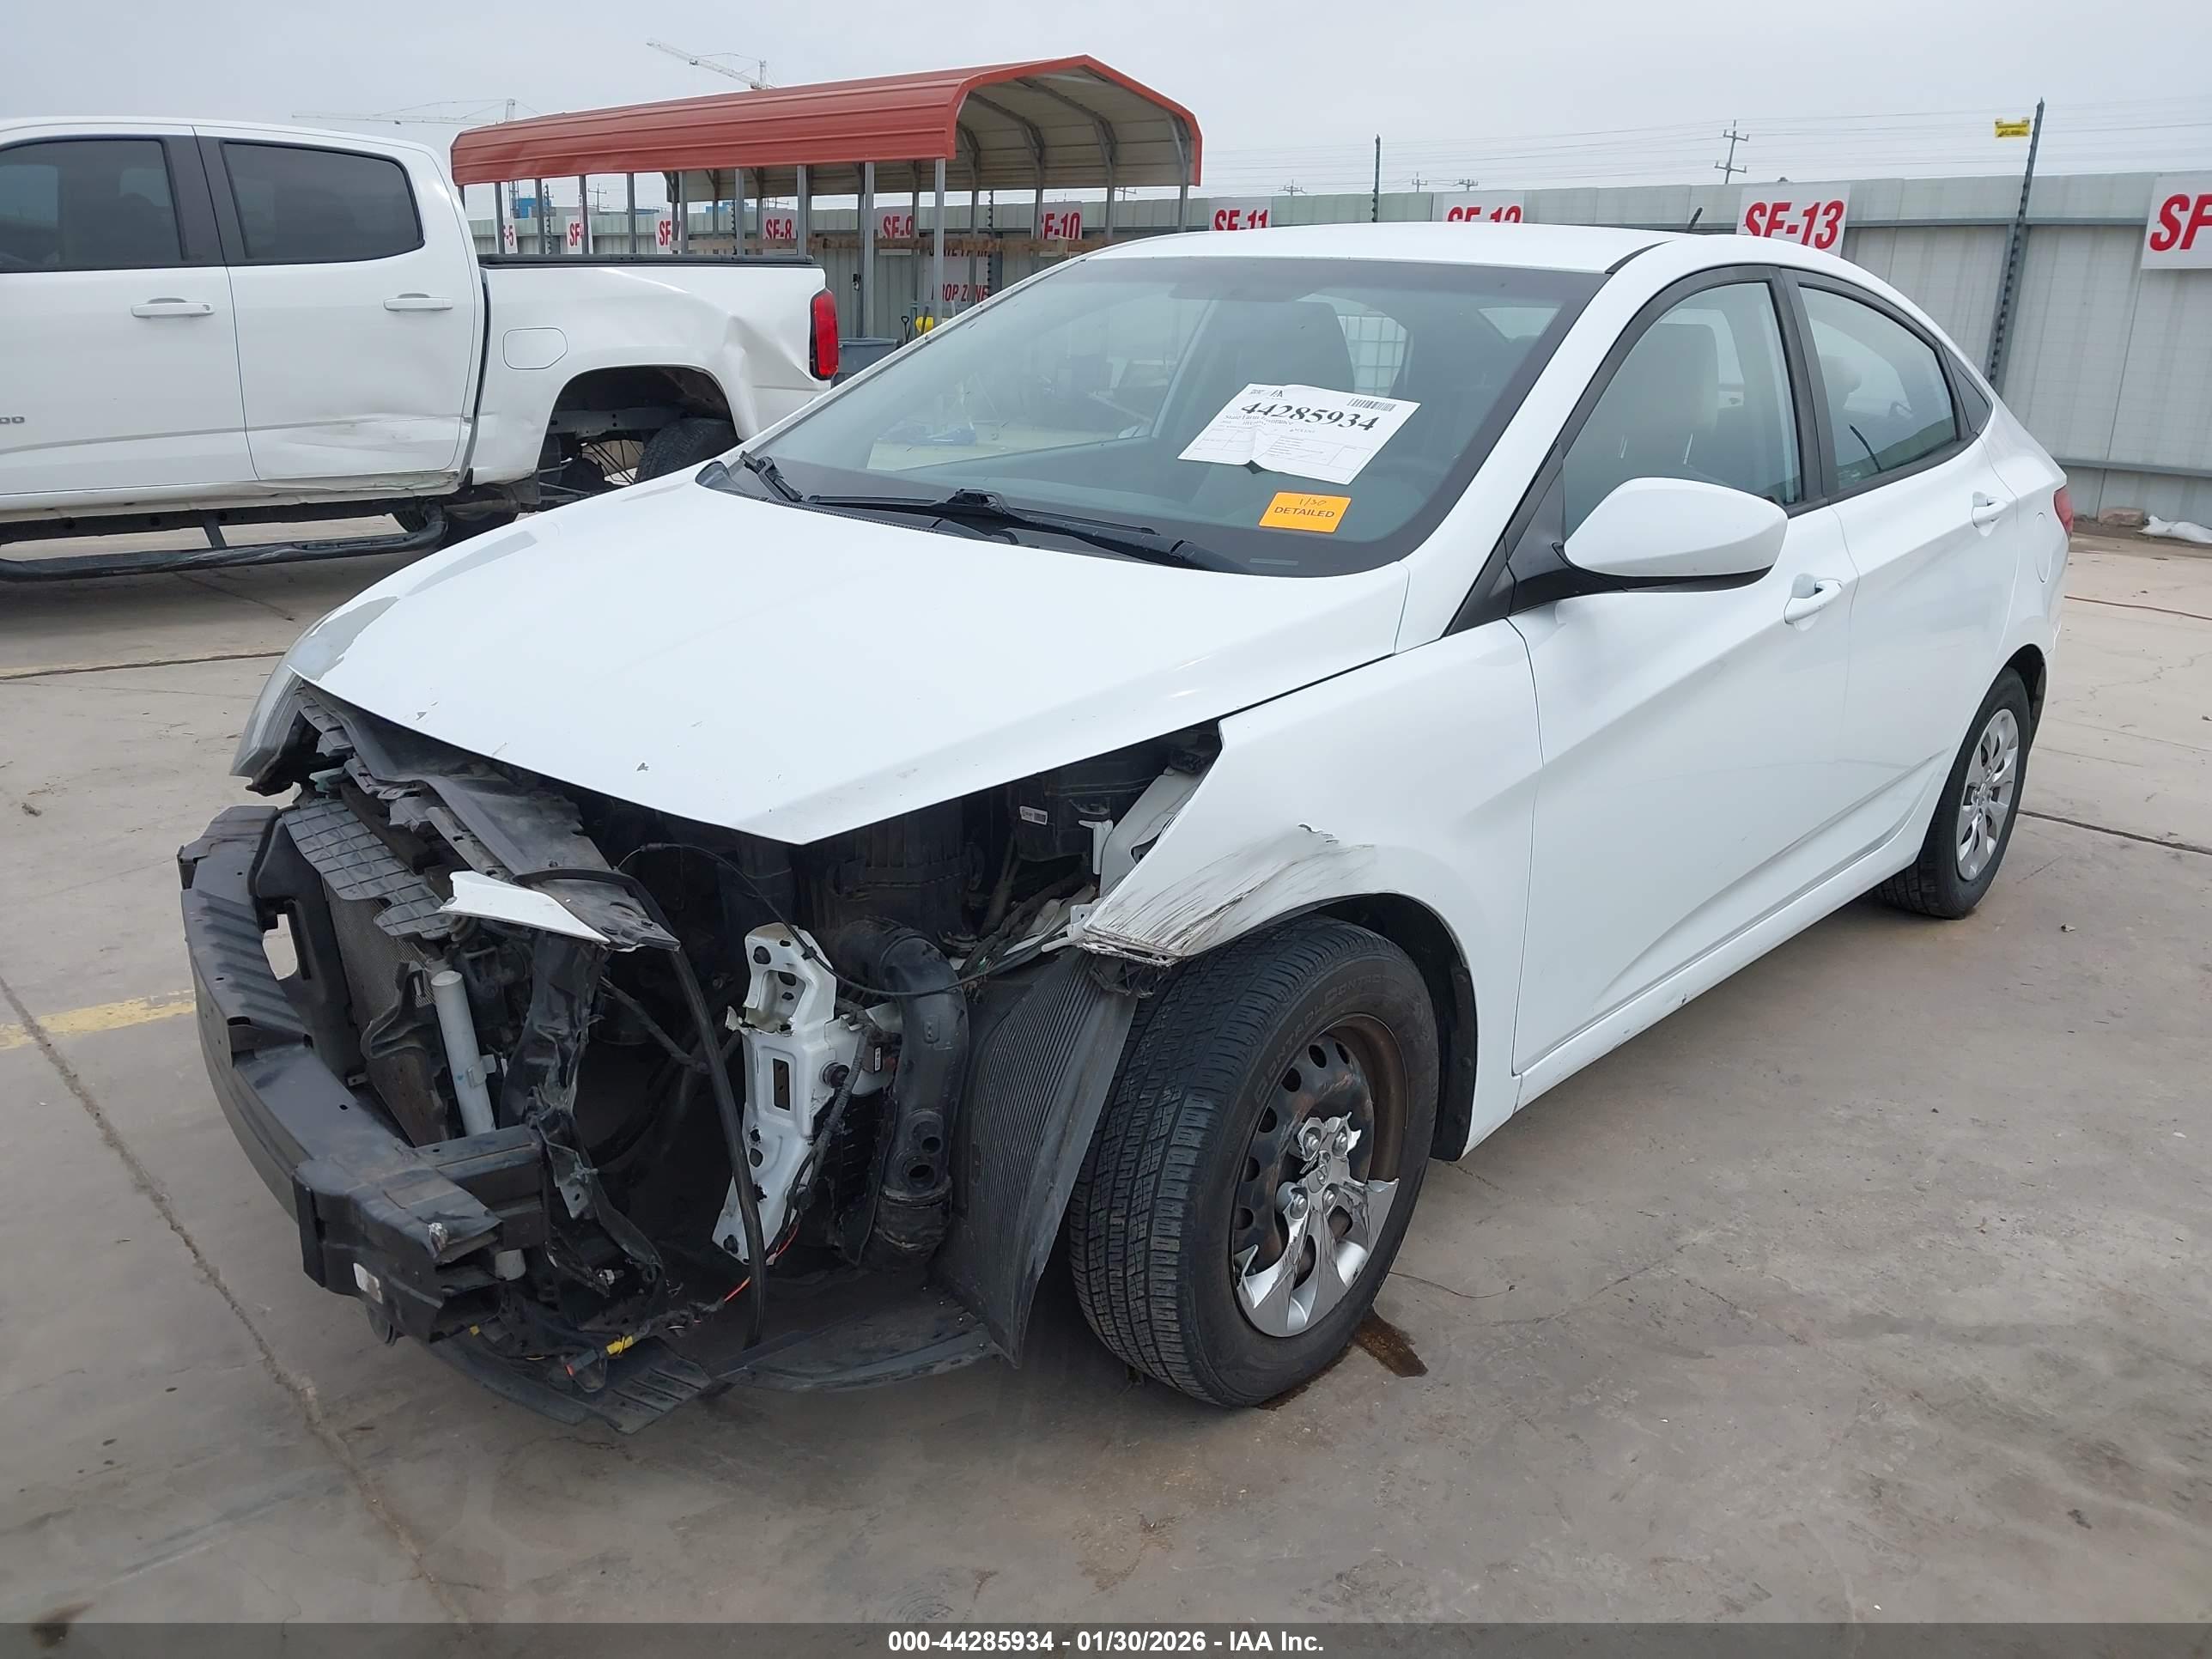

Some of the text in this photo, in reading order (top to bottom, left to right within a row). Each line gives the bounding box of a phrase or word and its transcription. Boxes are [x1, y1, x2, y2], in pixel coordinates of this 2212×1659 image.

[1041, 212, 1080, 239] F-10
[1744, 200, 1844, 249] SF-13
[961, 284, 989, 302] ZNE
[1241, 402, 1379, 431] 44285934
[1273, 507, 1334, 518] DETAILED
